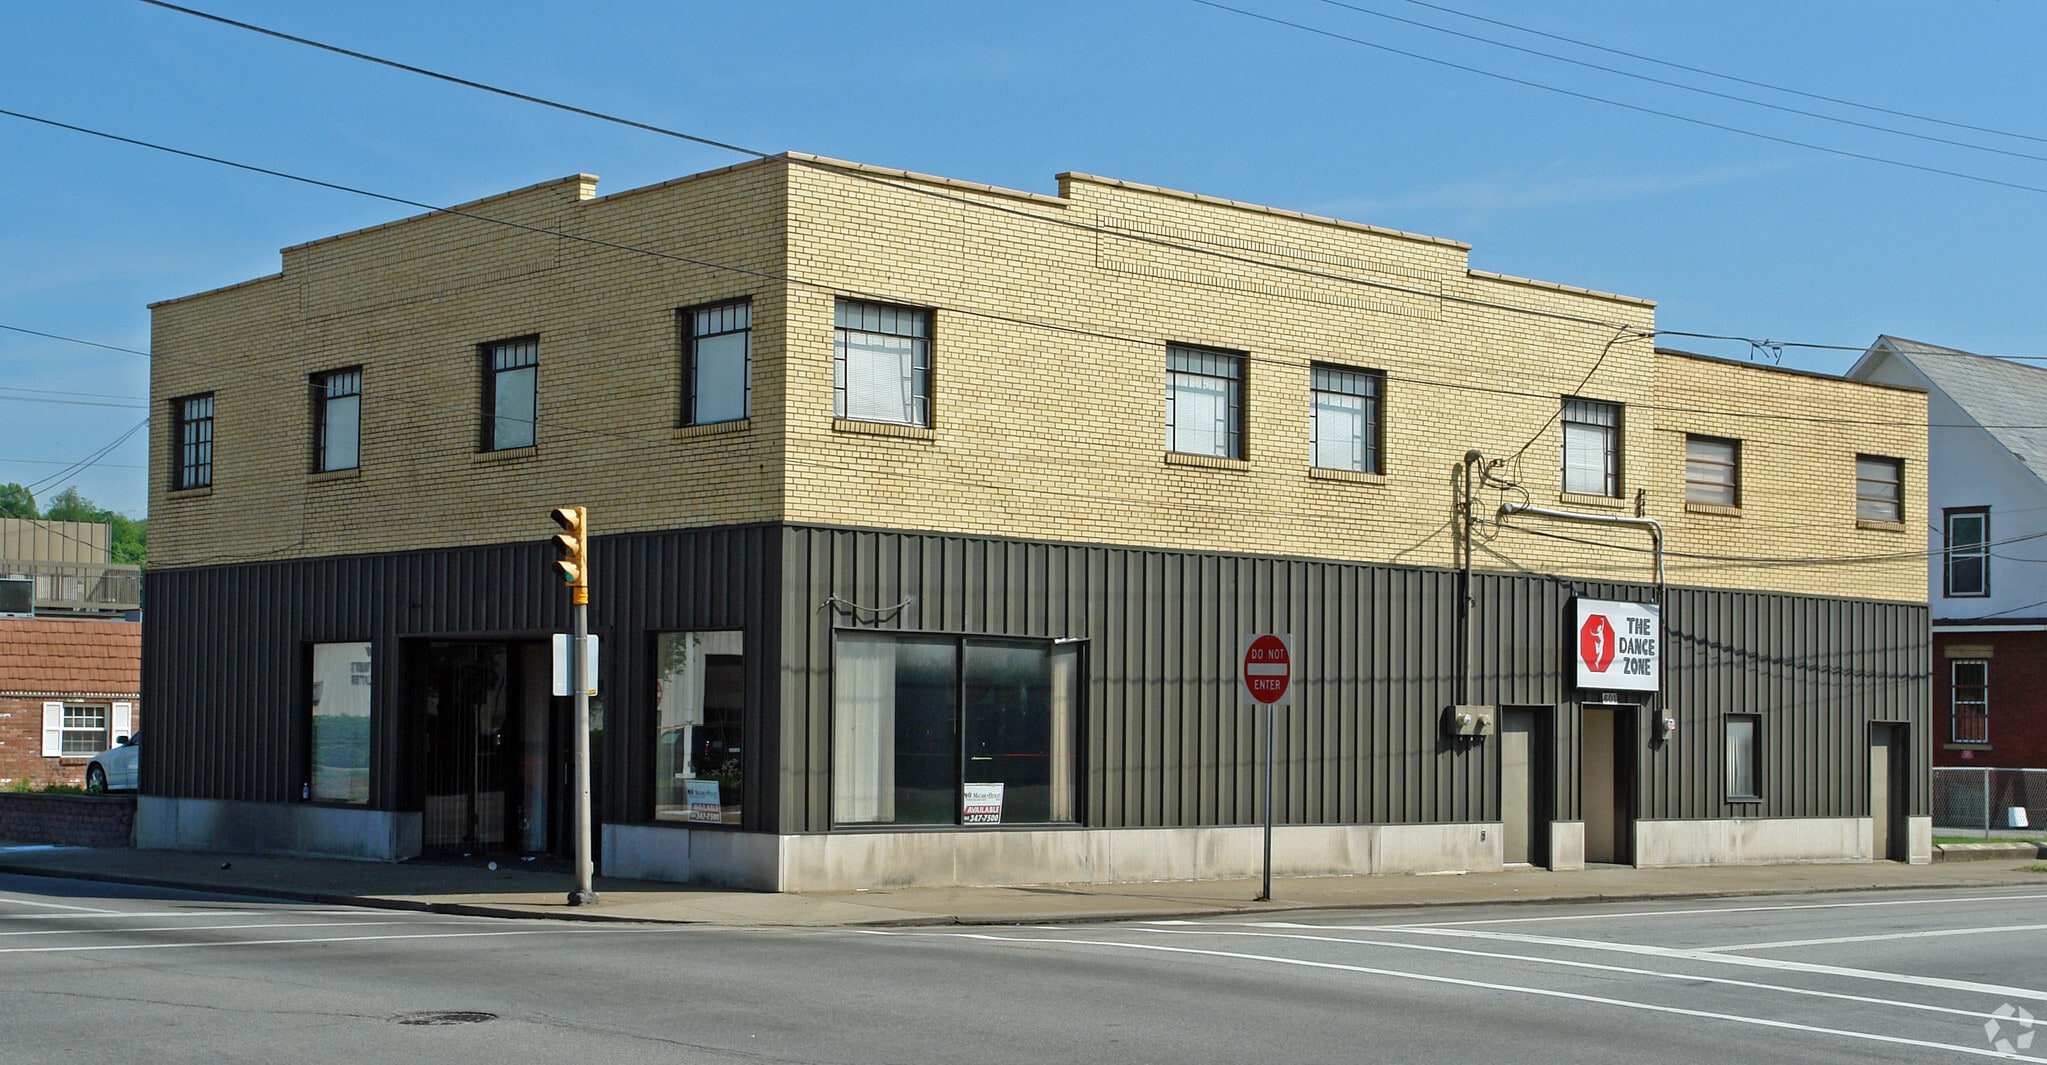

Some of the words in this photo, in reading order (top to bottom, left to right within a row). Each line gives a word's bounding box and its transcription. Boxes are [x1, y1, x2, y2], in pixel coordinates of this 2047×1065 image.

[1626, 617, 1651, 635] THE
[1251, 648, 1263, 659] DO
[1268, 648, 1285, 659] NOT
[1619, 637, 1655, 656] DANCE
[1623, 657, 1651, 676] ZONE
[1254, 679, 1281, 690] ENTER
[967, 806, 1000, 814] AVAILABLE
